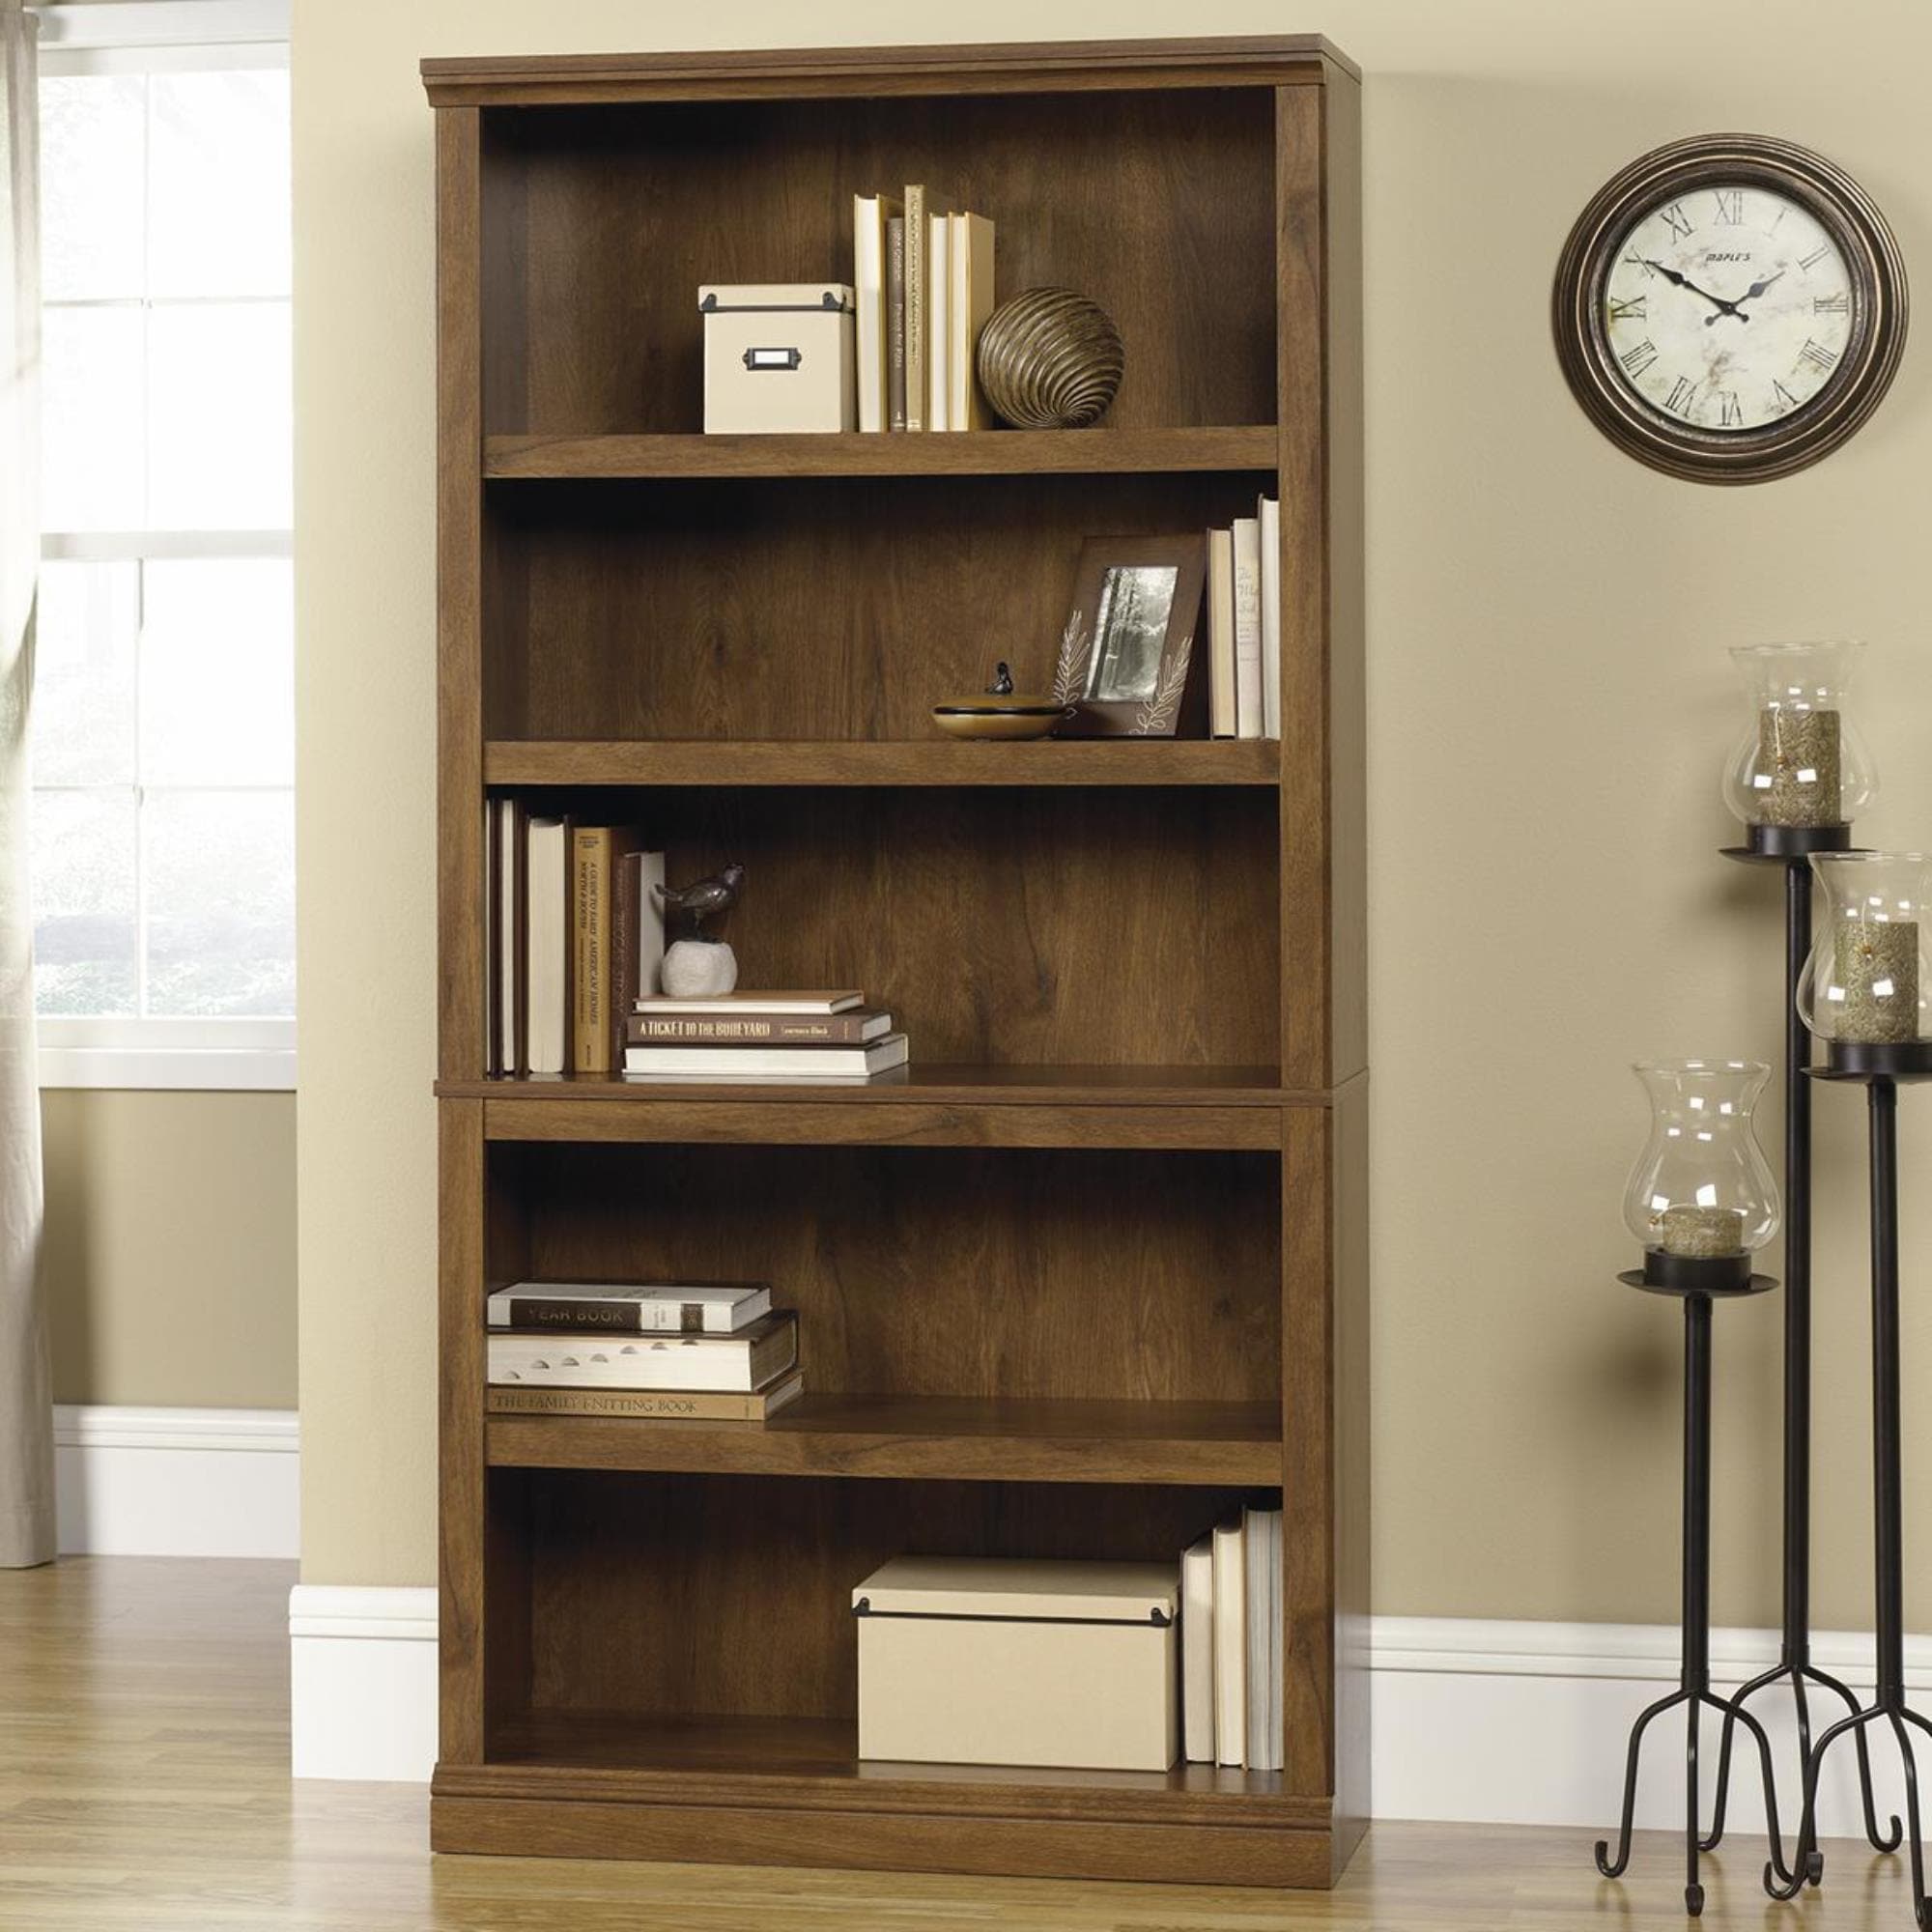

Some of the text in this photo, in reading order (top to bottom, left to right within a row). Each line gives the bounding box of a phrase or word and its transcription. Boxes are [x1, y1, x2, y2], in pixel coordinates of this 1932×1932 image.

[589, 938, 598, 991] AMERICAN
[639, 1021, 647, 1037] A
[648, 1021, 684, 1037] TICKET
[685, 1022, 696, 1037] TO
[697, 1023, 715, 1037] THE
[576, 1307, 624, 1323] BOOK
[495, 1395, 526, 1409] THE
[526, 1396, 580, 1410] FAMILY
[657, 1399, 697, 1413] BOOK
